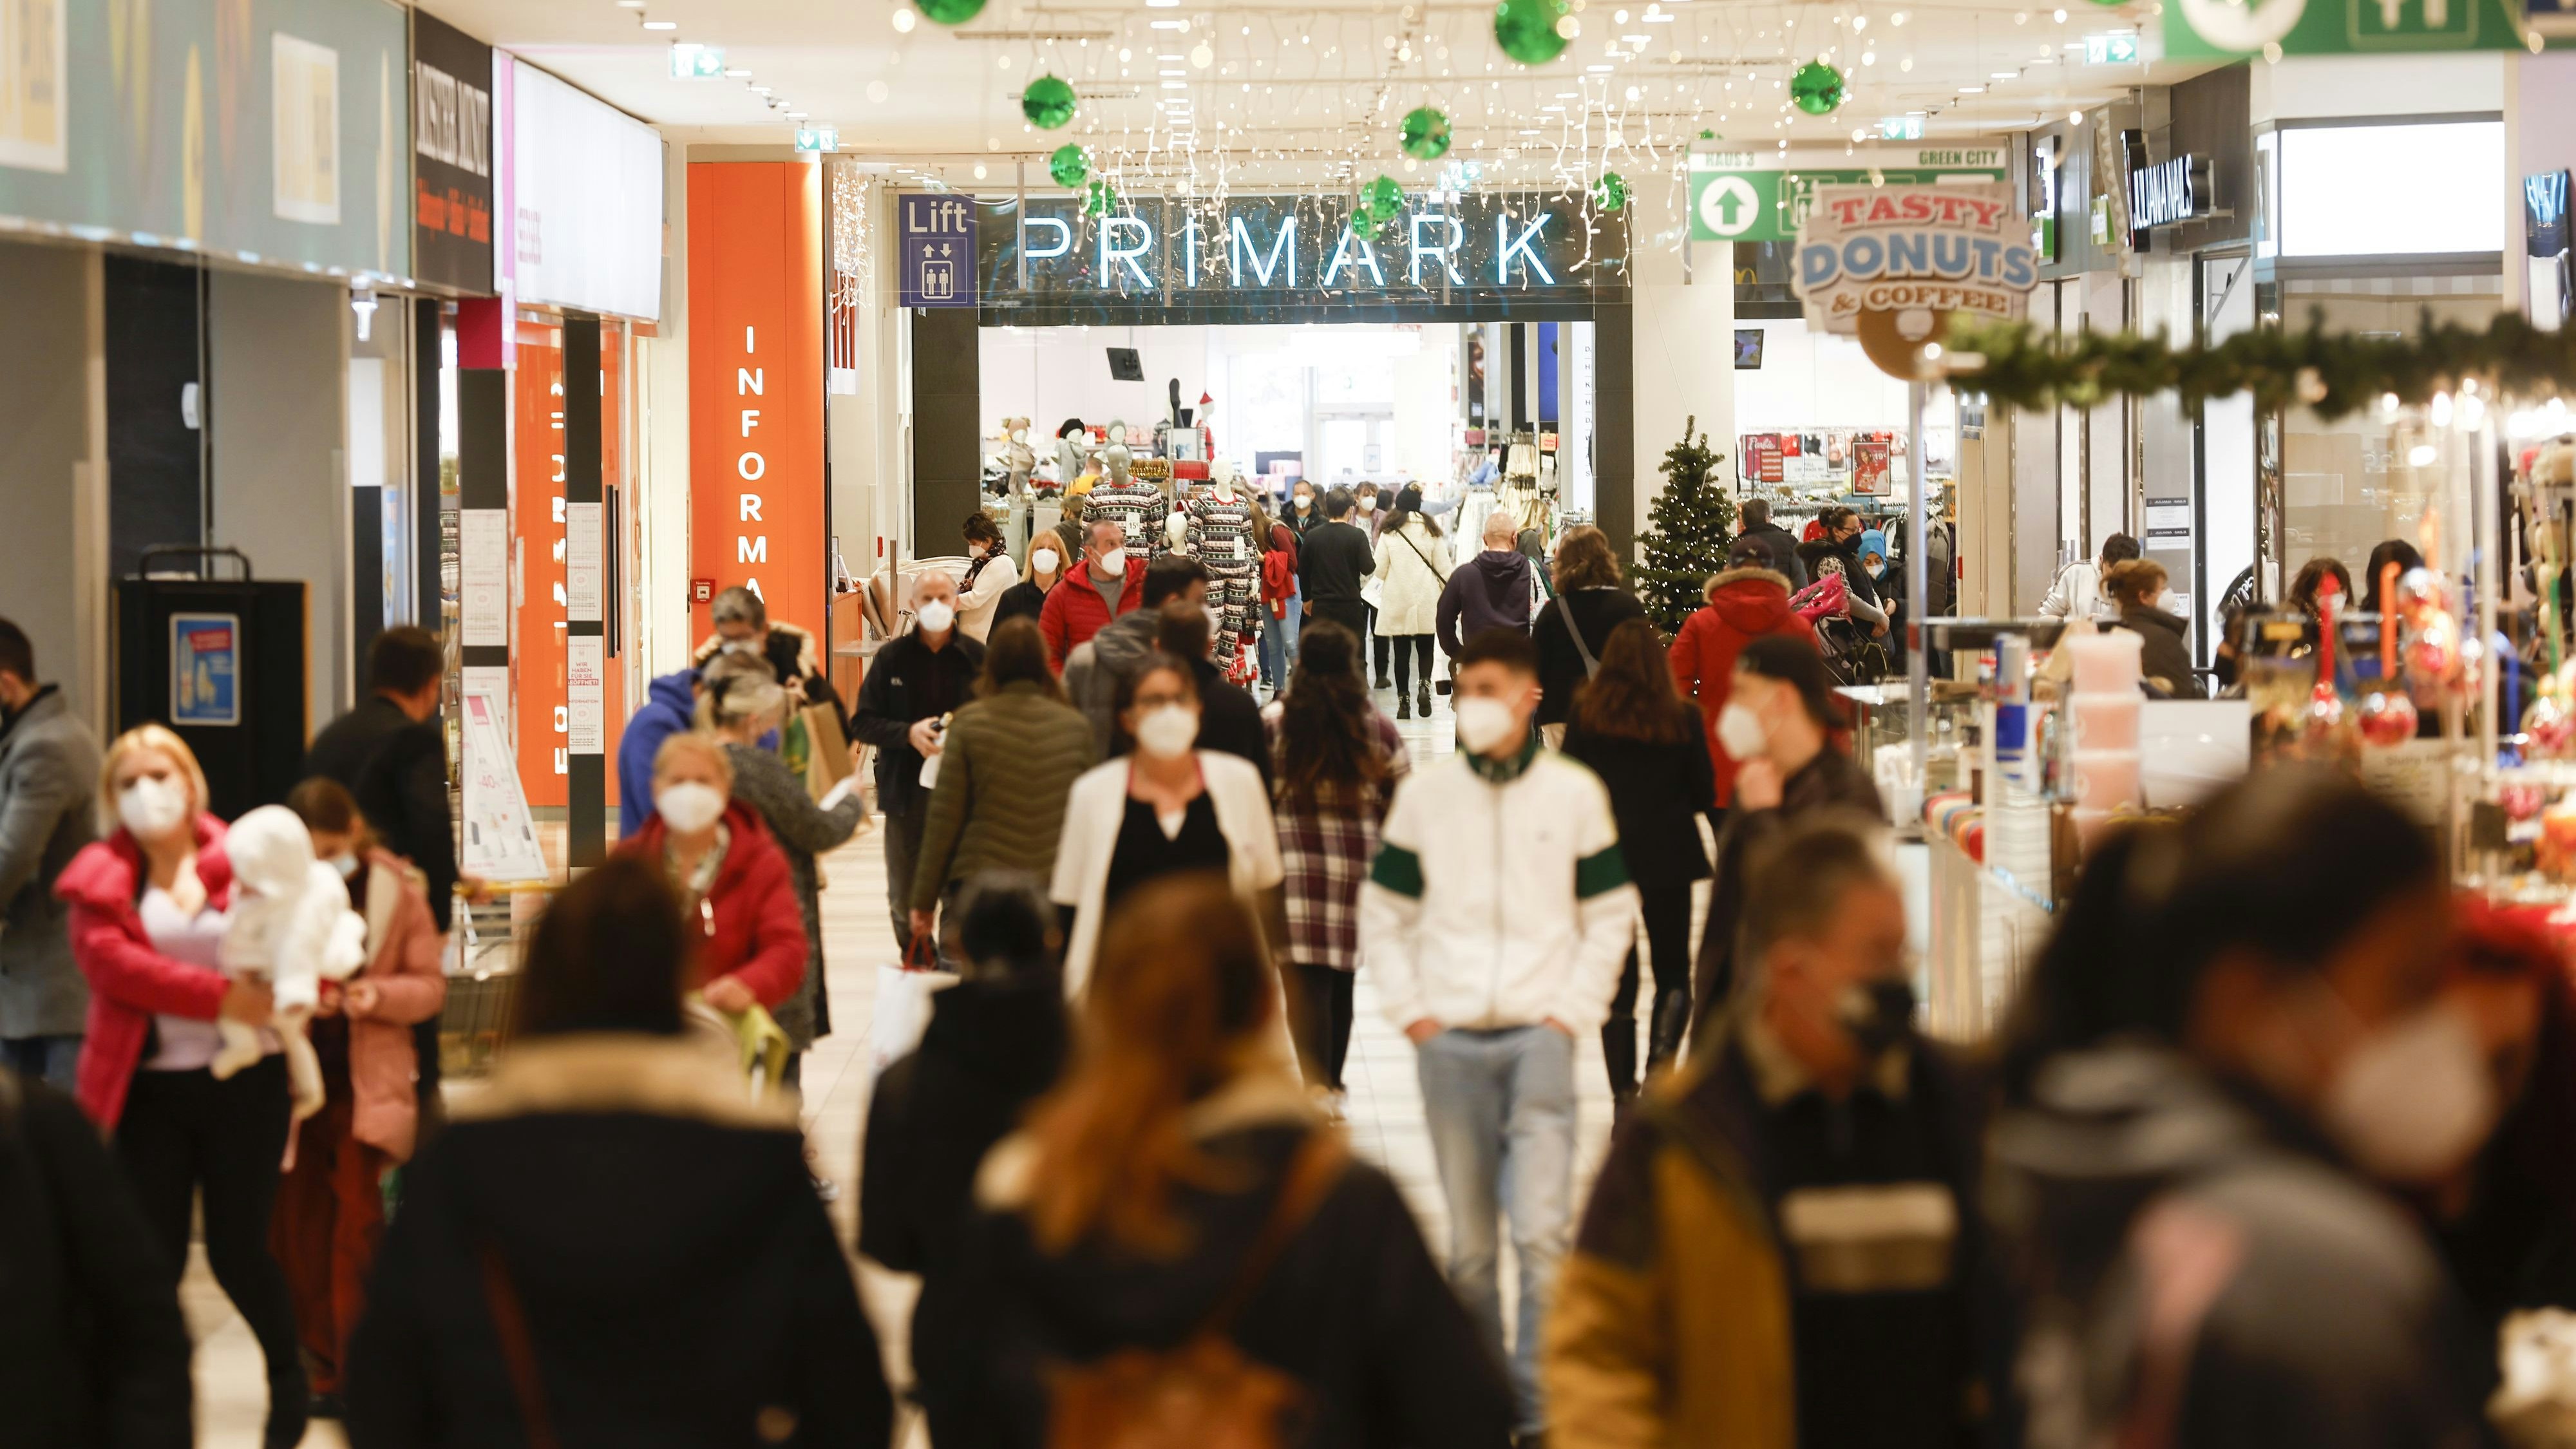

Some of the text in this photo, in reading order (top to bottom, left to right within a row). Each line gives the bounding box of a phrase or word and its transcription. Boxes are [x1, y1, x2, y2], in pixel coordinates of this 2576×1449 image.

[416, 60, 455, 165] MISTER
[1706, 152, 1755, 167] HAUS 3
[1919, 149, 1999, 166] GREEN CITY
[908, 201, 967, 233] Lift
[1832, 194, 2002, 227] TASTY
[1017, 213, 1556, 289] PRIMARK
[1802, 232, 2034, 285] DONUTS
[1832, 287, 2007, 313] & COFFEE
